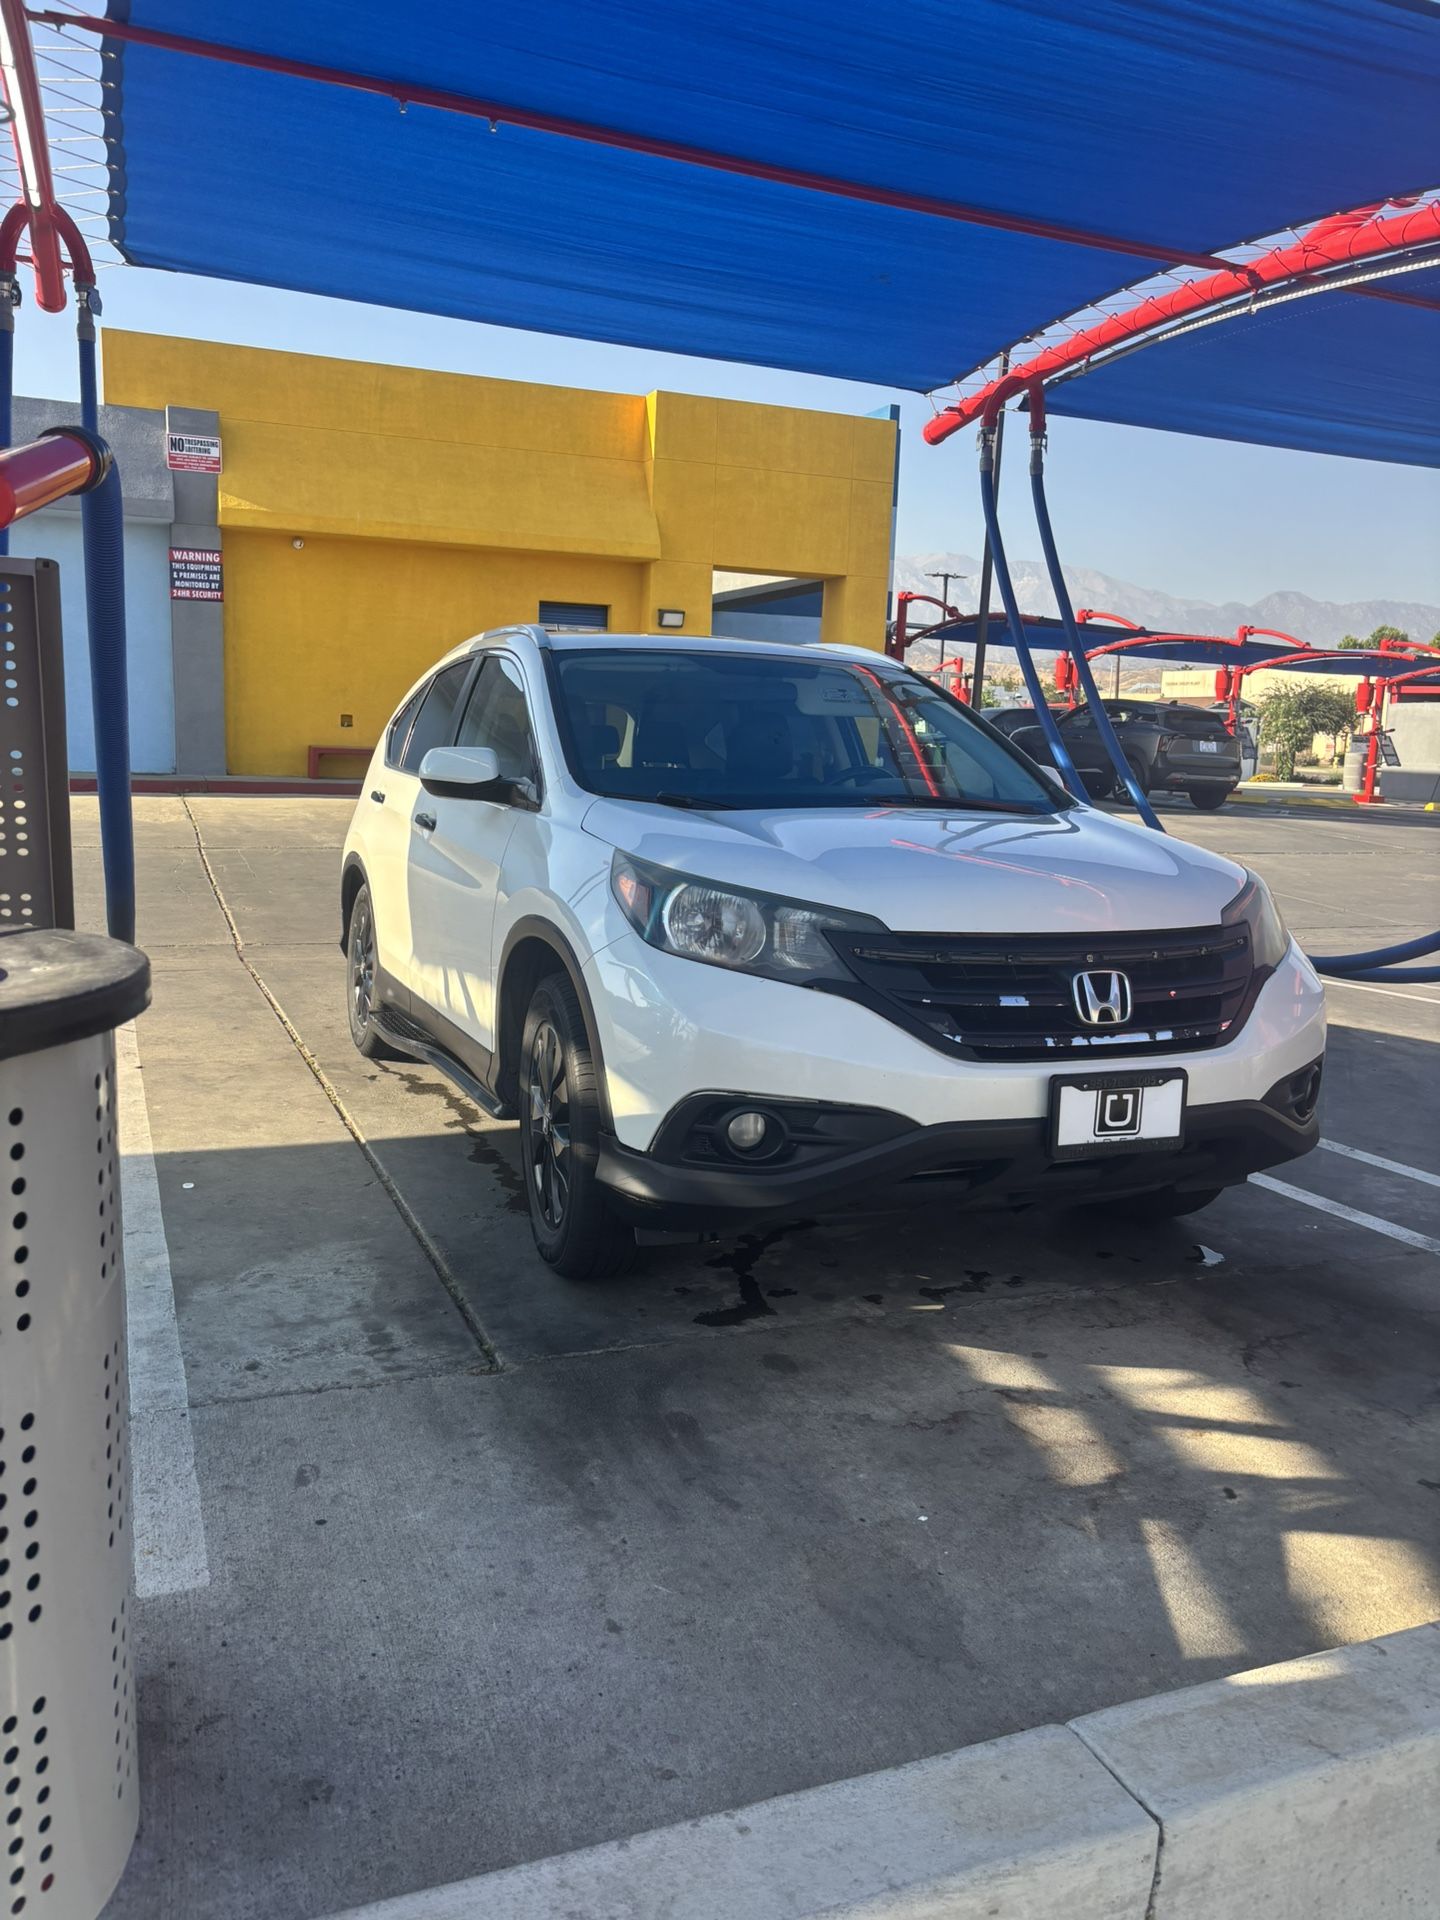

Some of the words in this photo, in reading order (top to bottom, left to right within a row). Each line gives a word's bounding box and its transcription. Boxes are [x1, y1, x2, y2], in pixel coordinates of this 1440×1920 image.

[170, 436, 185, 452] NO
[184, 438, 219, 448] TRESPASSING
[184, 446, 211, 455] LOITERING
[172, 550, 220, 563] WARNING
[172, 562, 186, 570] THIS
[186, 563, 221, 572] EQUIPMENT
[179, 571, 208, 580] PREMISES
[209, 573, 220, 581] ARE
[174, 580, 210, 589] MONITORED
[211, 582, 220, 590] BY
[172, 589, 191, 598] 24HR
[191, 590, 222, 599] SECURITY
